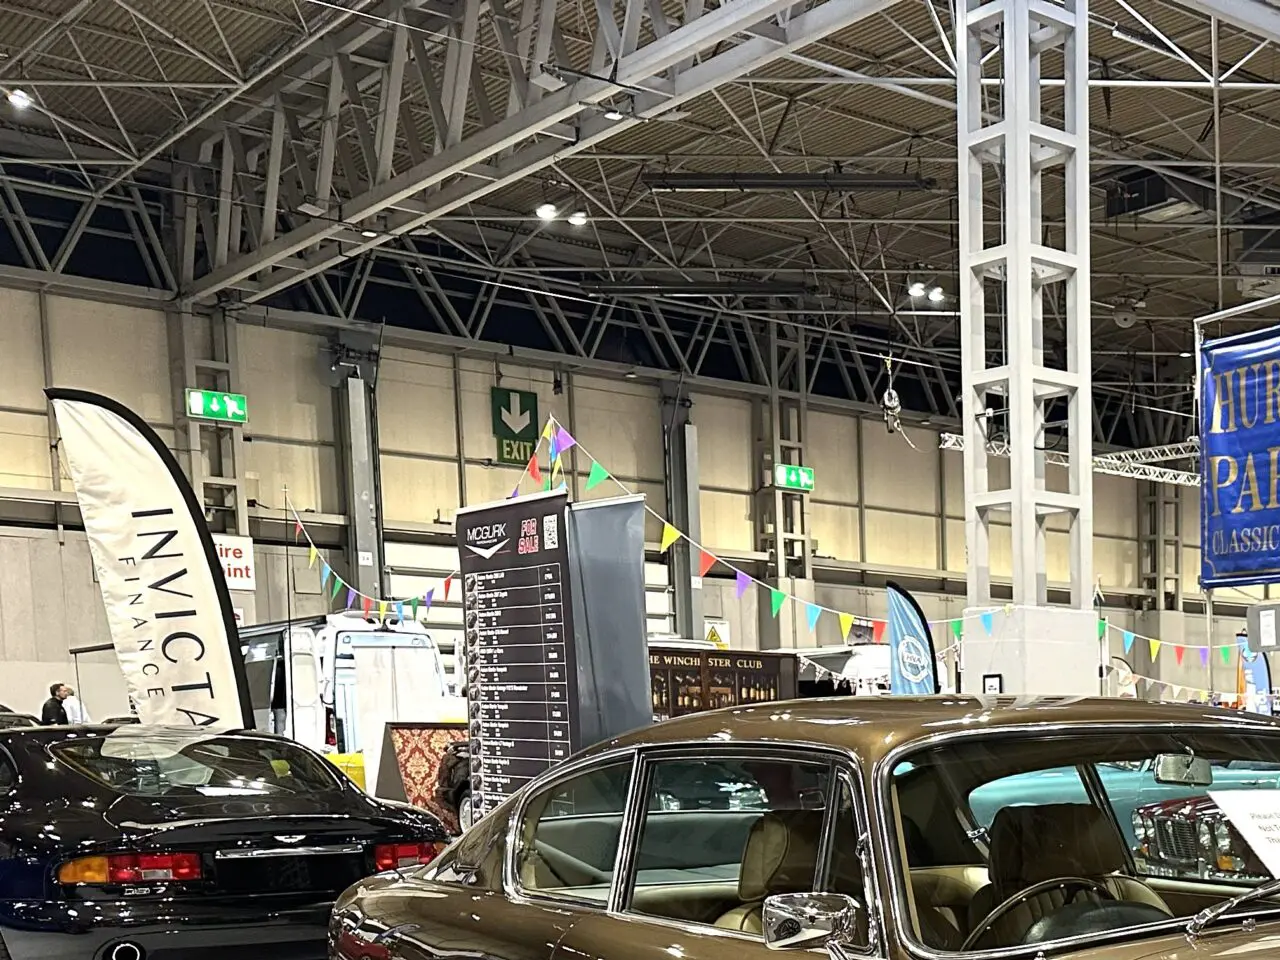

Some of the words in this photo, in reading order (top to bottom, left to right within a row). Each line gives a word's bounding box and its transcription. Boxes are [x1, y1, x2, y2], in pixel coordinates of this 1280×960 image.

[503, 439, 532, 461] EXIT
[467, 523, 507, 542] MCGURK
[521, 518, 537, 537] FOR
[518, 535, 539, 554] SALE
[1212, 524, 1280, 556] CLASSIC
[216, 543, 243, 559] ire
[117, 556, 165, 698] FINANCE
[736, 659, 763, 669] CLUB
